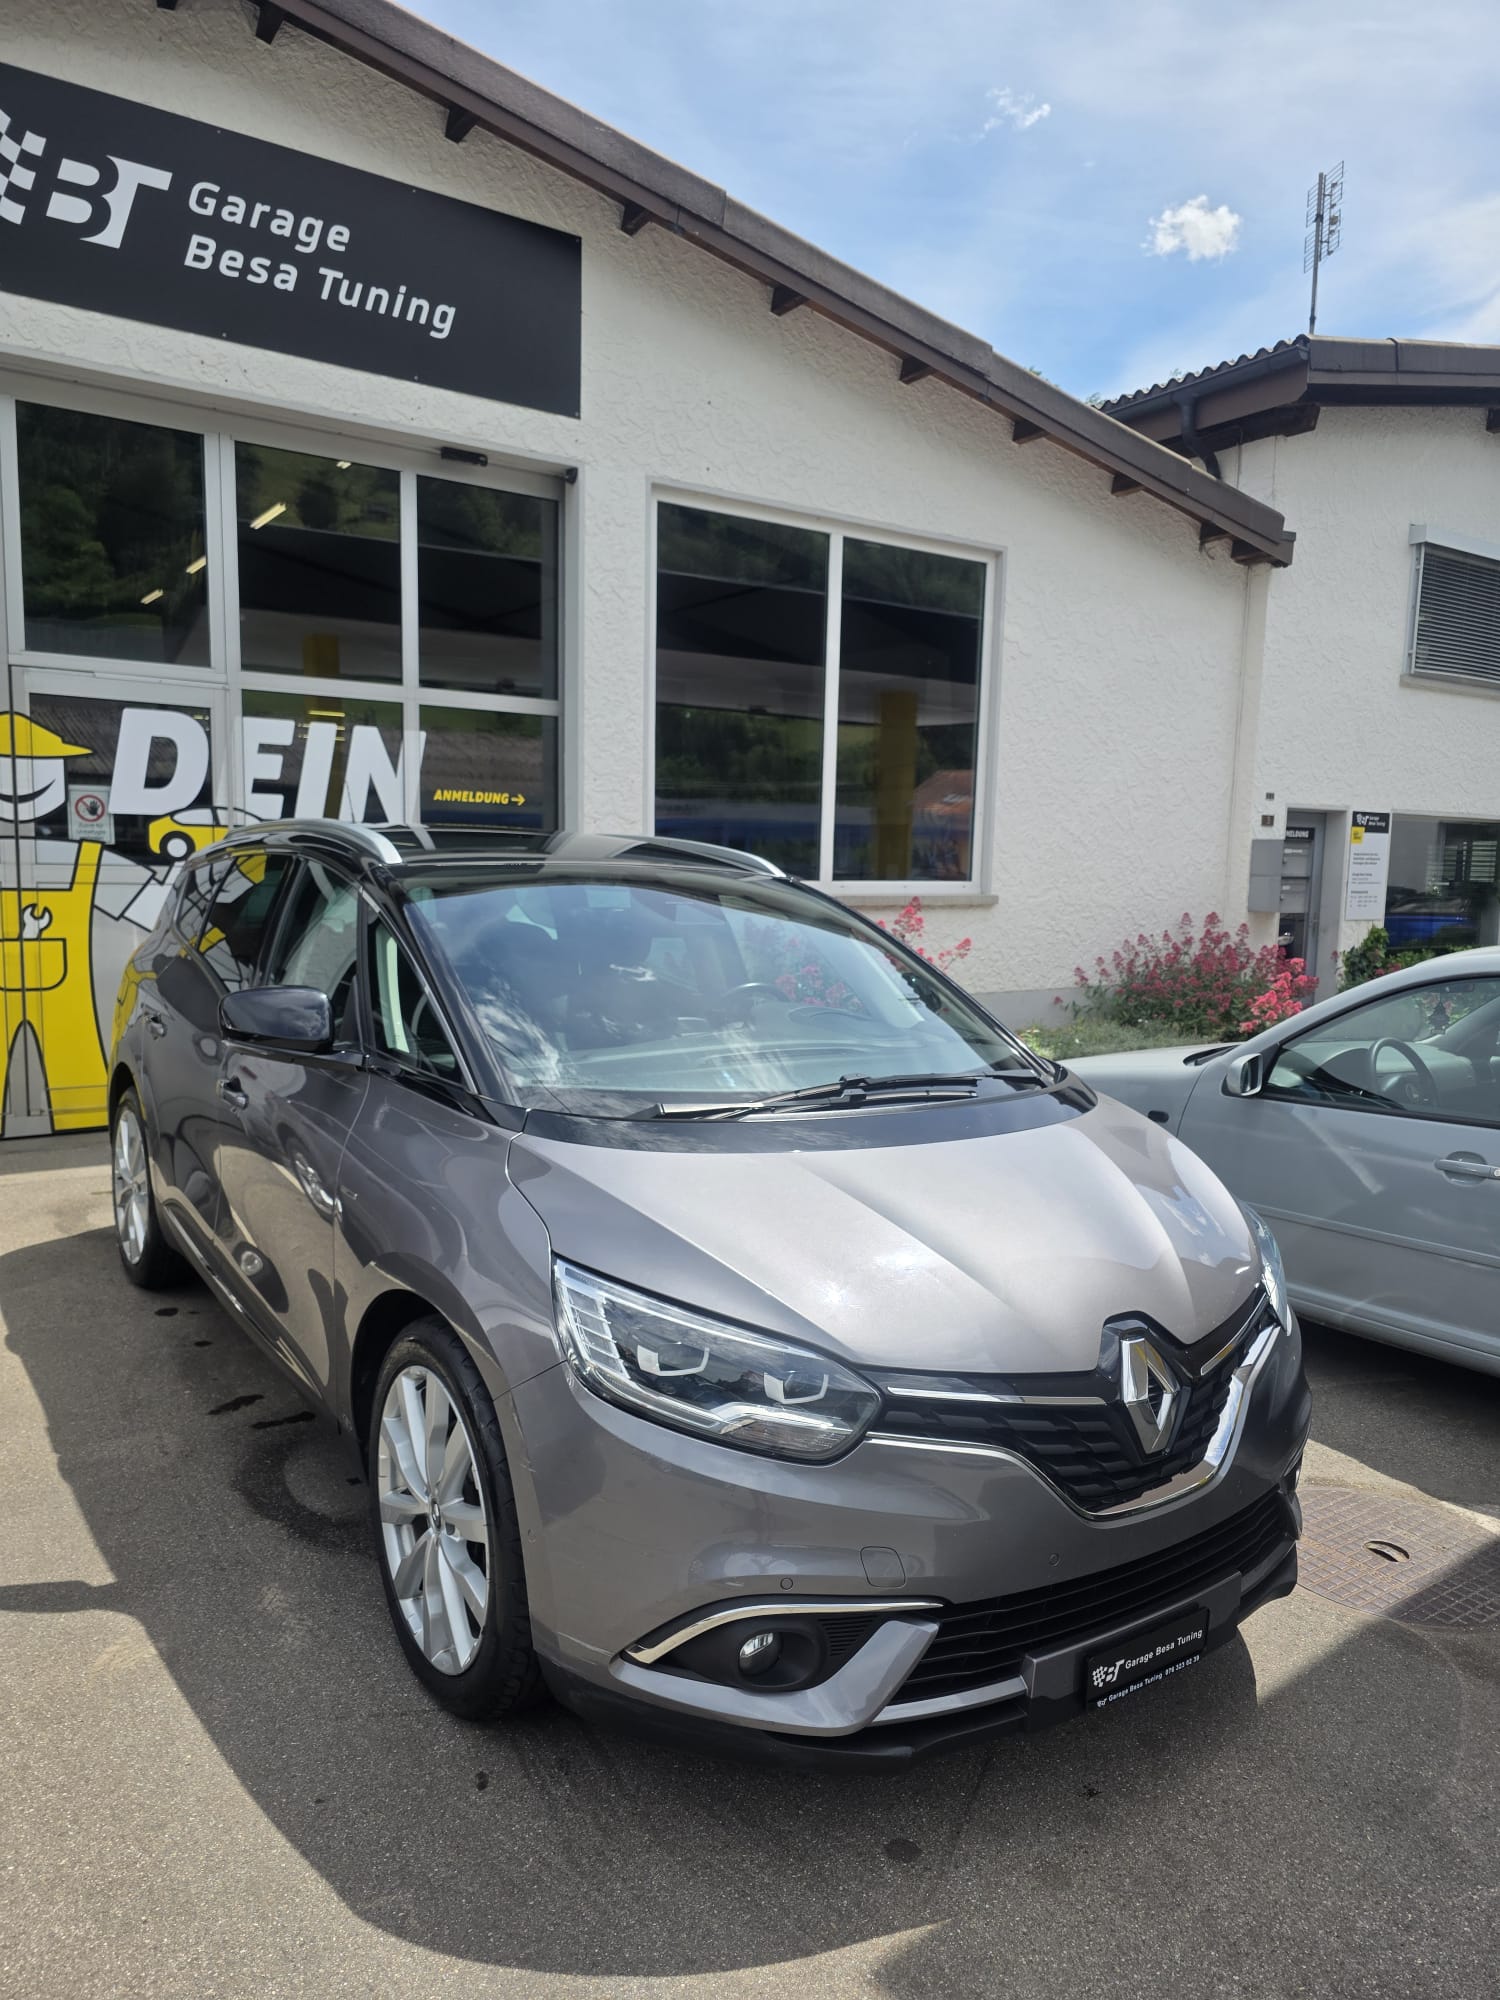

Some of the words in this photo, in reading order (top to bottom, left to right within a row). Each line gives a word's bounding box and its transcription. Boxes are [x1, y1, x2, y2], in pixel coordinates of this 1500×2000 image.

[188, 181, 351, 253] Garage
[184, 234, 298, 292] Besa
[318, 267, 457, 339] Tuning
[108, 707, 427, 825] DEIN
[433, 788, 510, 805] ANMELDUNG
[1125, 1651, 1154, 1670] Garage
[1156, 1642, 1175, 1656] Besa
[1177, 1629, 1203, 1646] Tuning
[1108, 1688, 1129, 1701] Garage
